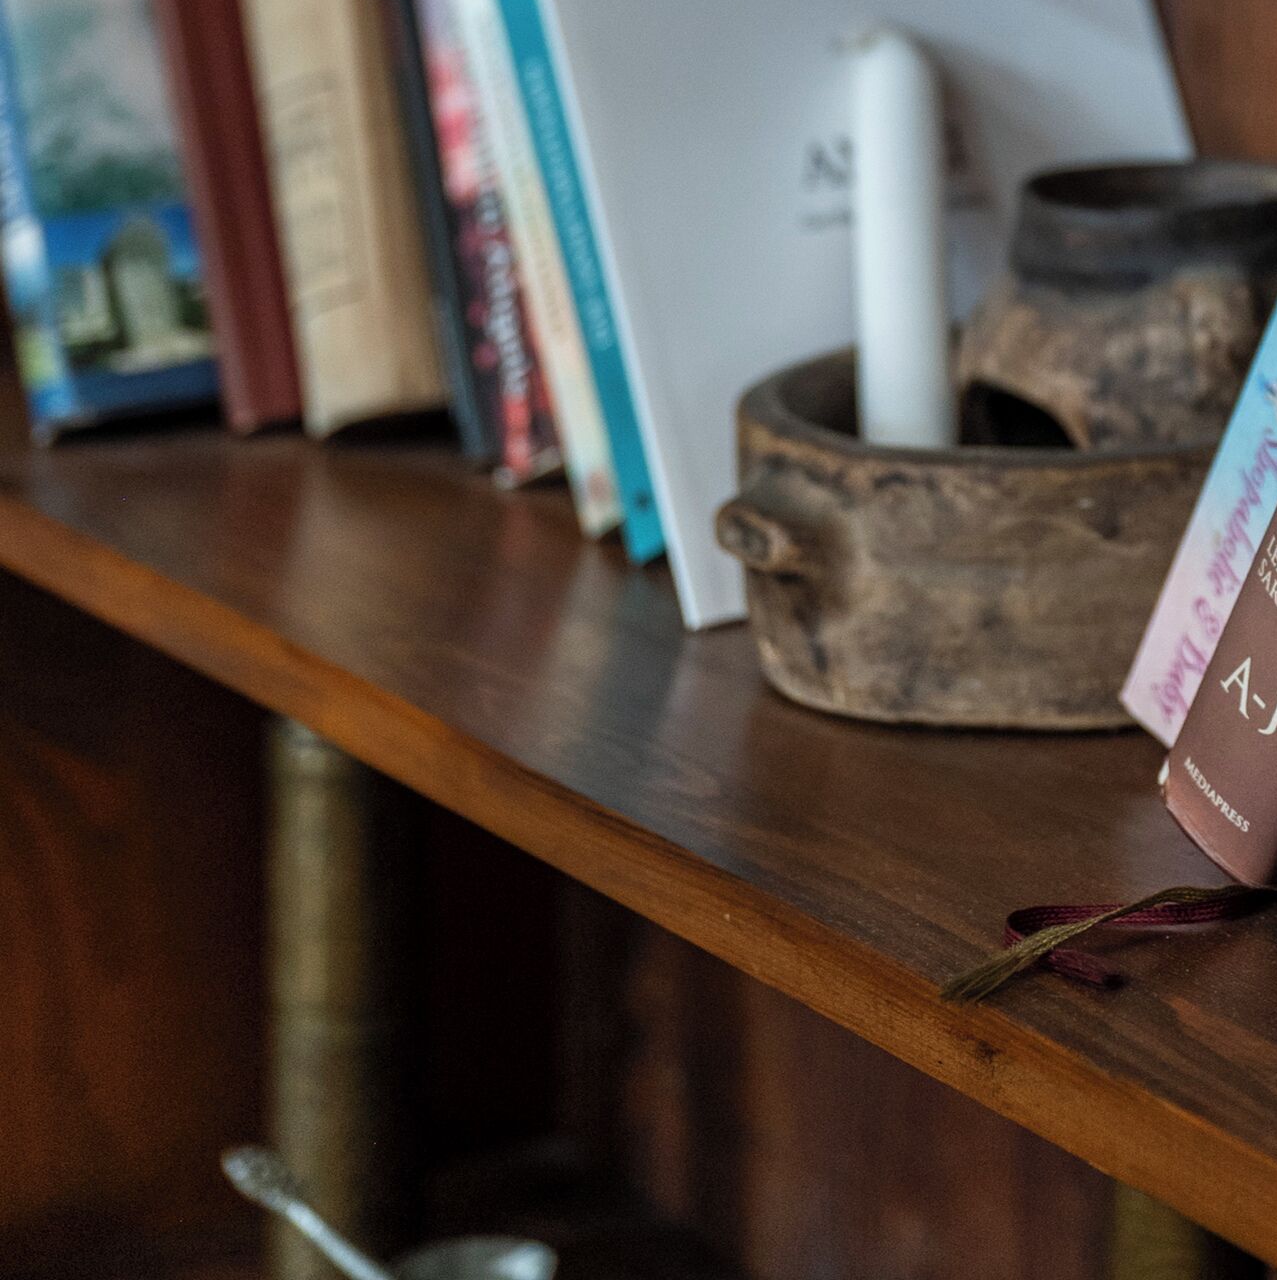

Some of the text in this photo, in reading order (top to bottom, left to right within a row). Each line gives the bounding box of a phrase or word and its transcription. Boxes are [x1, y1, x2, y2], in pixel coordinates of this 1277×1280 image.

[1193, 596, 1221, 638] &
[1152, 635, 1208, 725] Baby
[1183, 756, 1251, 833] MEDIAPRESS
